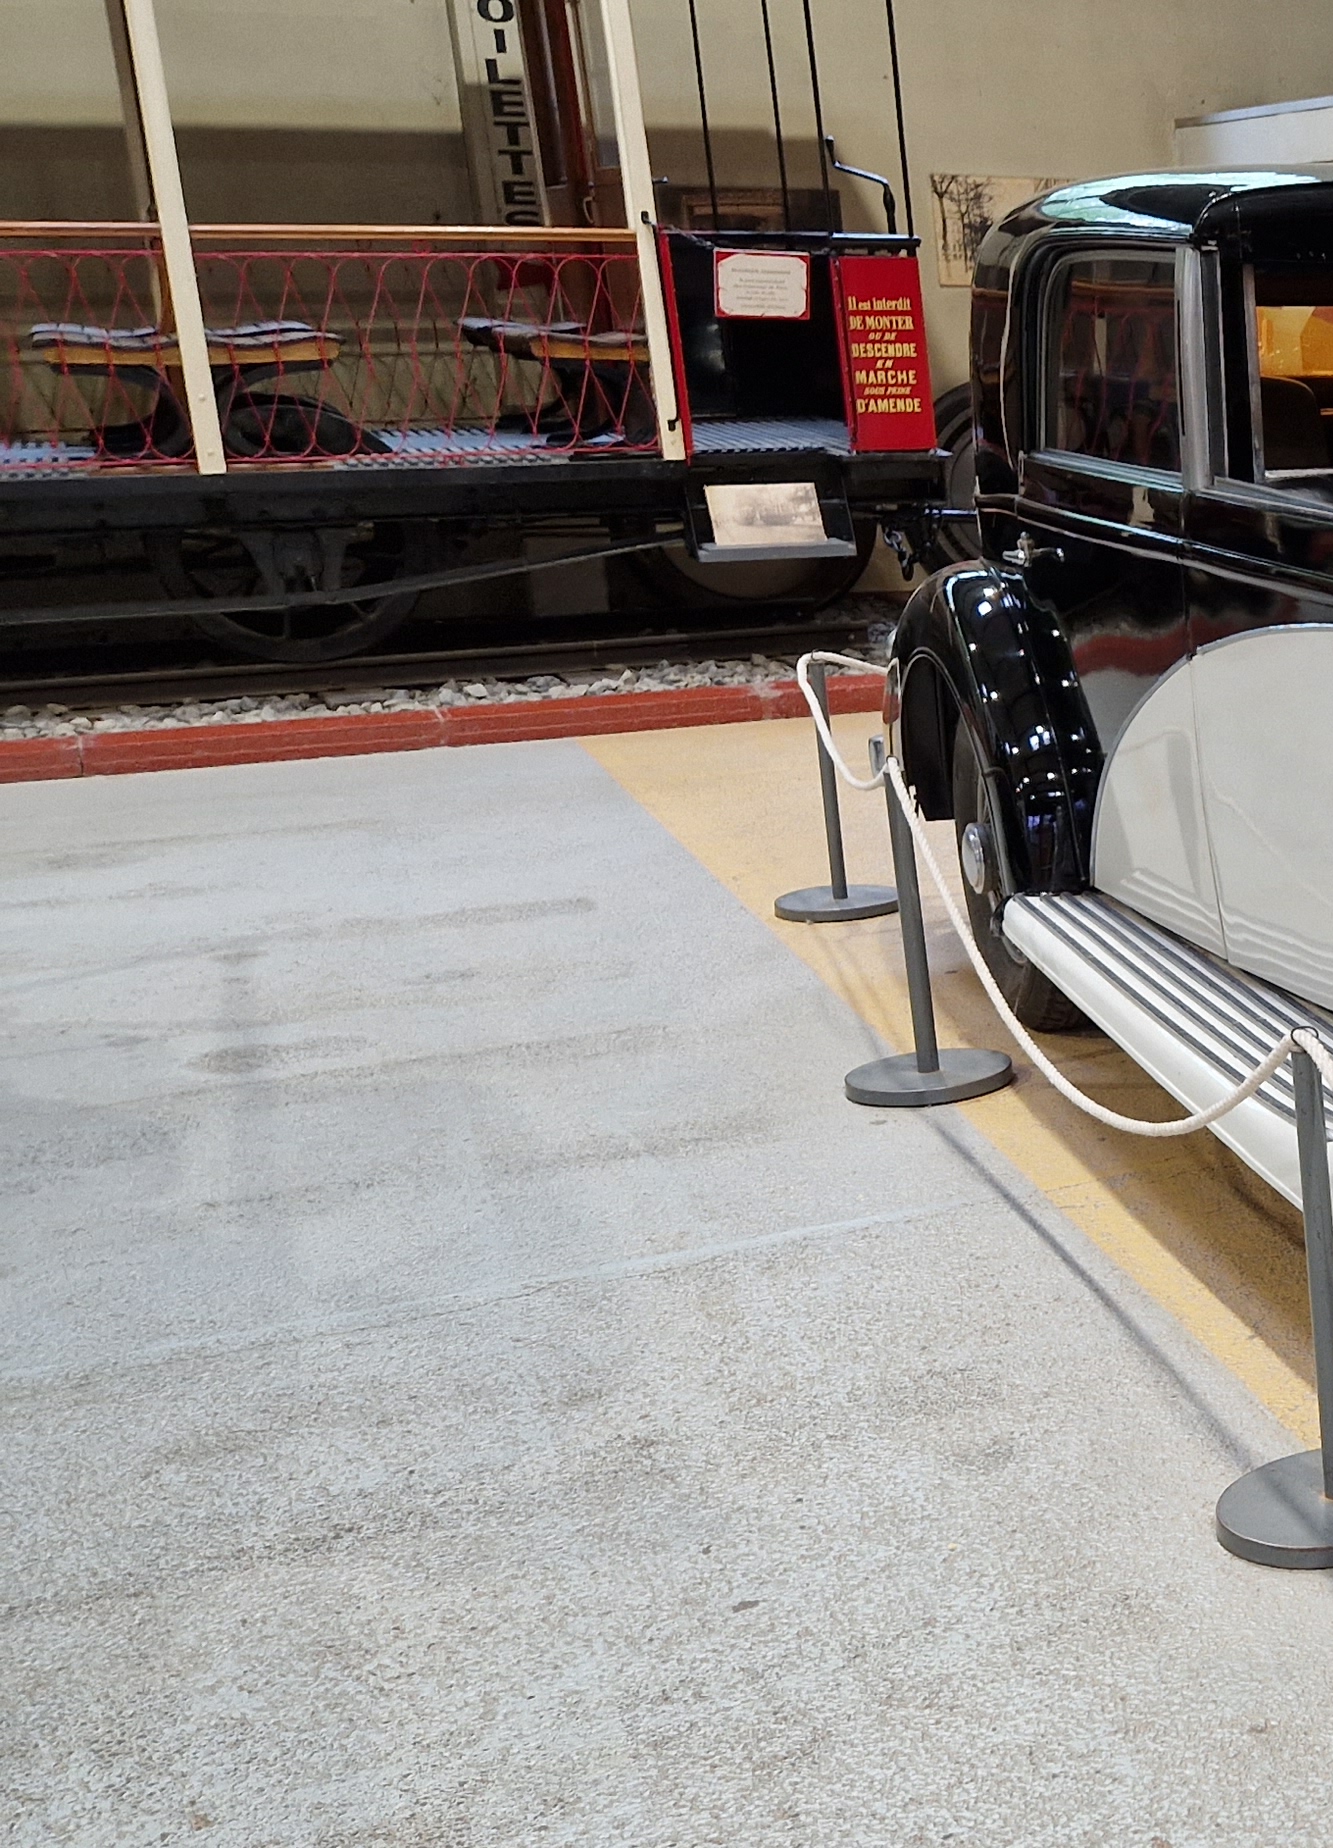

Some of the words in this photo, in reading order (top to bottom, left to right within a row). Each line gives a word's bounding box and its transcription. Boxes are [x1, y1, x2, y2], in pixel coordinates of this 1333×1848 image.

[477, 0, 540, 226] OILETTES
[848, 296, 857, 311] Il
[858, 300, 871, 311] est
[872, 297, 912, 311] interdit
[849, 316, 864, 330] DE
[865, 315, 914, 330] MONTER
[868, 332, 882, 340] OU
[883, 332, 897, 340] DE
[851, 343, 917, 358] DESCENDRE
[875, 359, 894, 369] EN
[855, 370, 917, 385] MARCHE
[864, 386, 886, 395] SOUS
[856, 398, 922, 414] D'AMENDE
